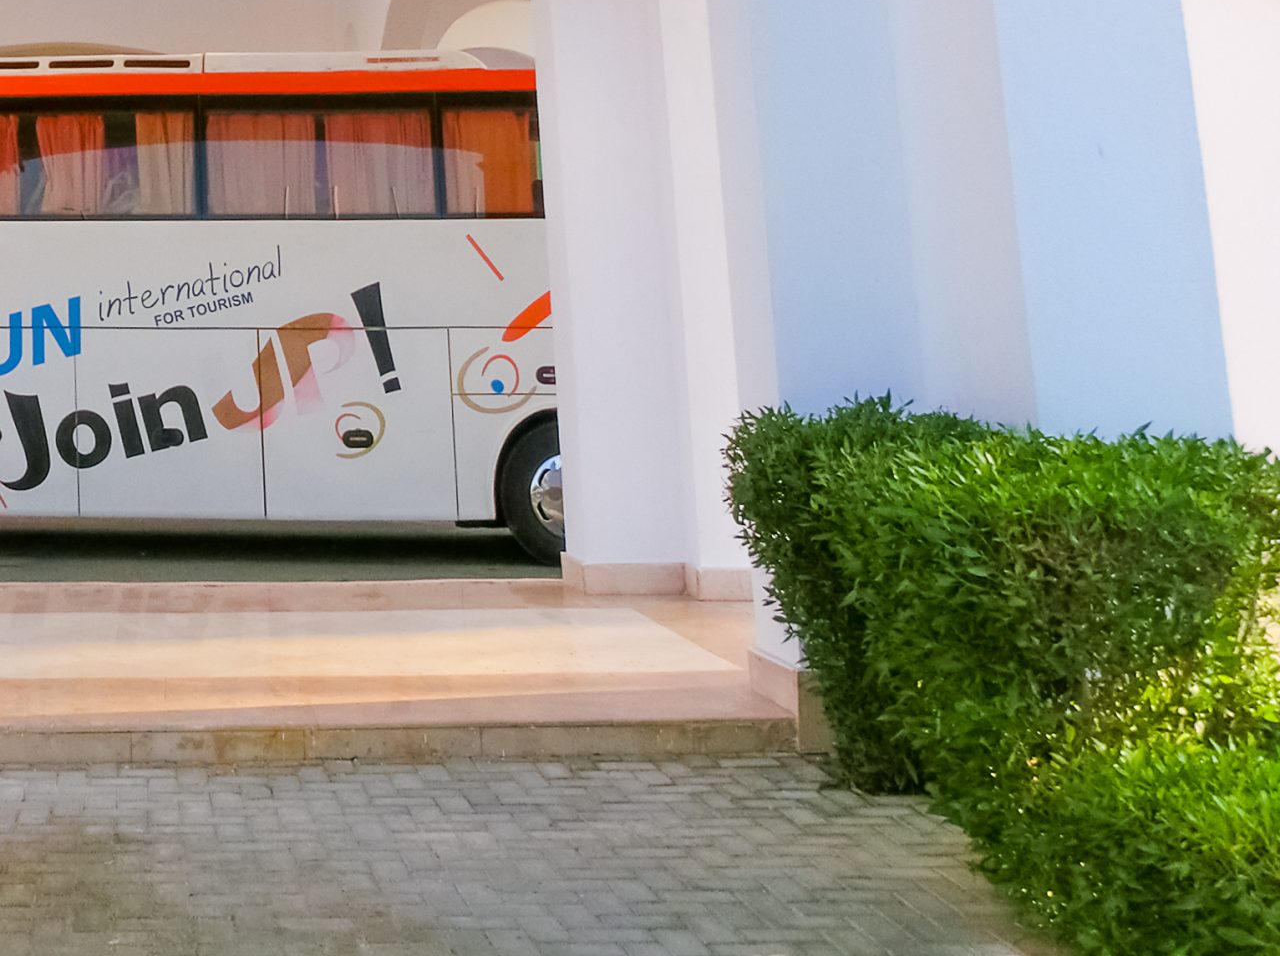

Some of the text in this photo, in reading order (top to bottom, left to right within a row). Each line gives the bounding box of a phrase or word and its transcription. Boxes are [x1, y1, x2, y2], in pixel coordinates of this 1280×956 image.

[99, 245, 281, 321] international
[154, 292, 254, 326] FOR TOURISM
